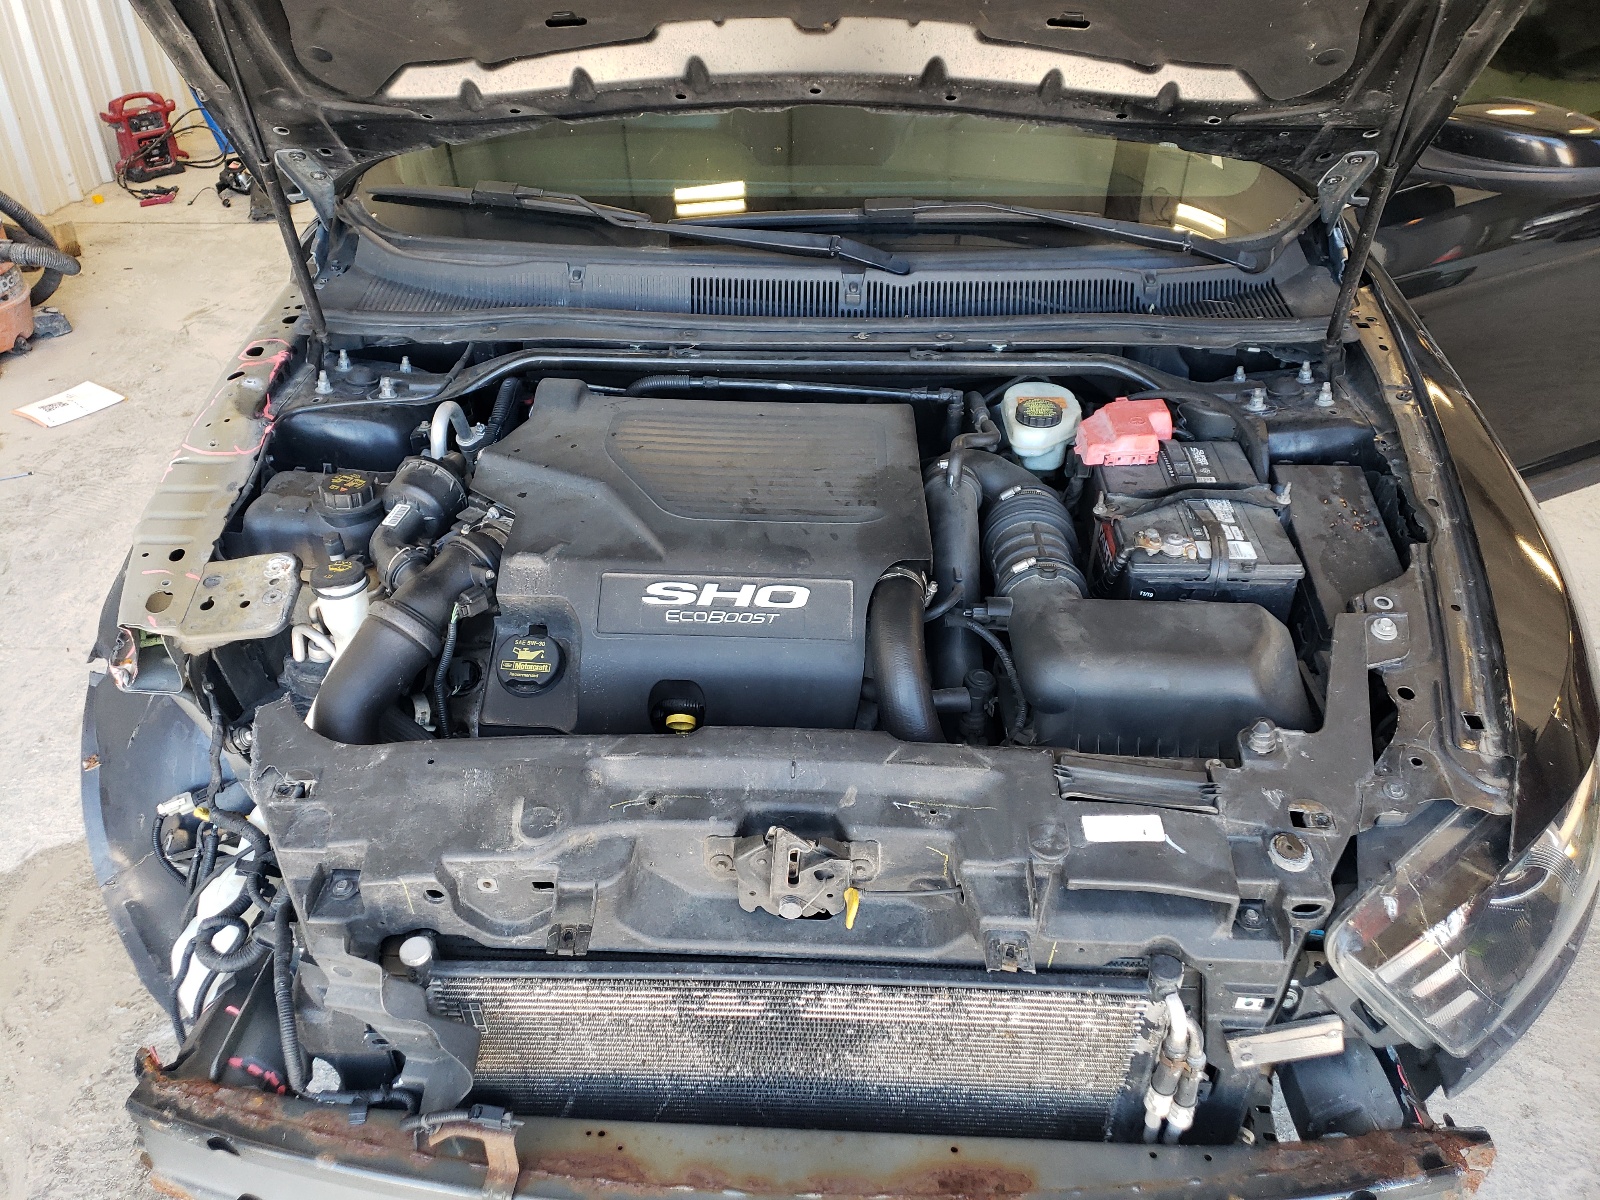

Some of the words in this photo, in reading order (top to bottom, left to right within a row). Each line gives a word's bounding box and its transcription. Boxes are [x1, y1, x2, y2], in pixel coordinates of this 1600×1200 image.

[641, 581, 811, 609] SHO
[665, 609, 780, 625] ECOBOOST
[514, 662, 549, 671] Motorcraft
